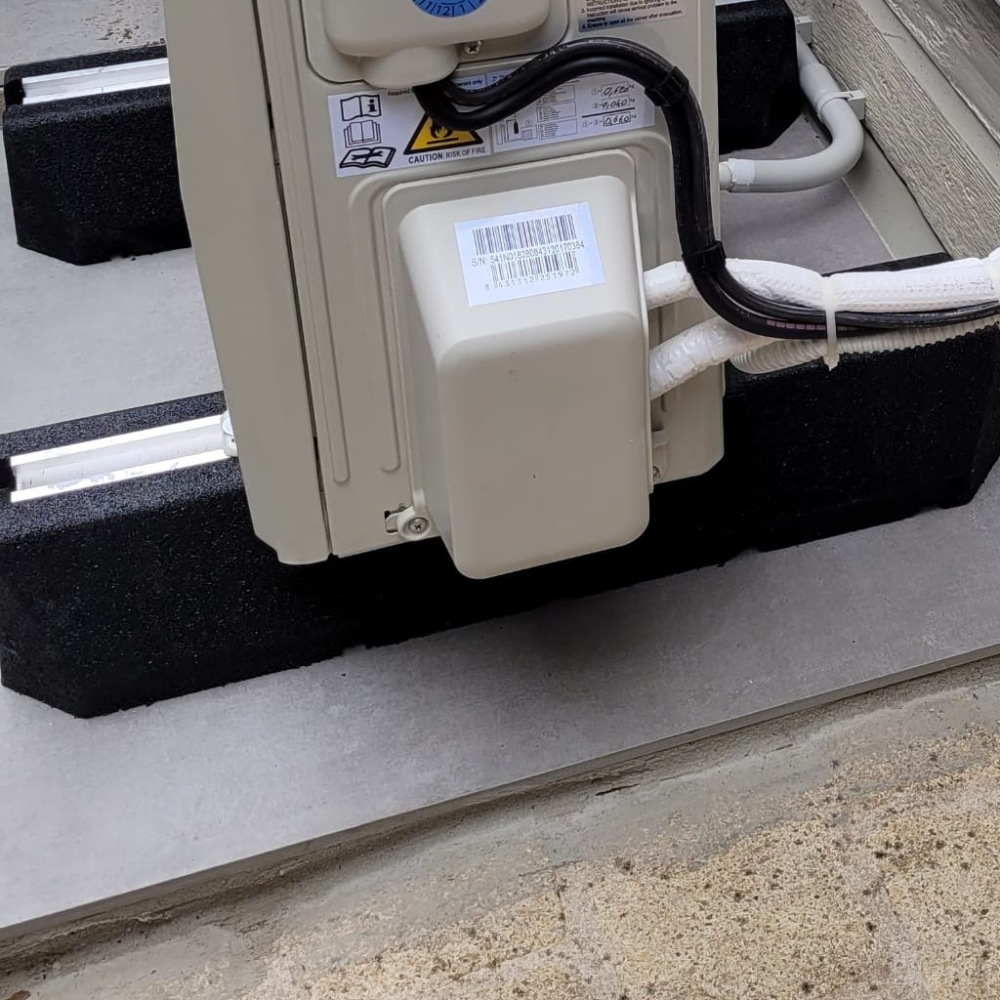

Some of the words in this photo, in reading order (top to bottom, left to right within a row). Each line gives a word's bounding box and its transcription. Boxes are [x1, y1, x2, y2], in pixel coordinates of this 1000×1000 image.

[437, 6, 450, 16] 12
[446, 150, 460, 159] RISK
[472, 146, 486, 154] FIRE
